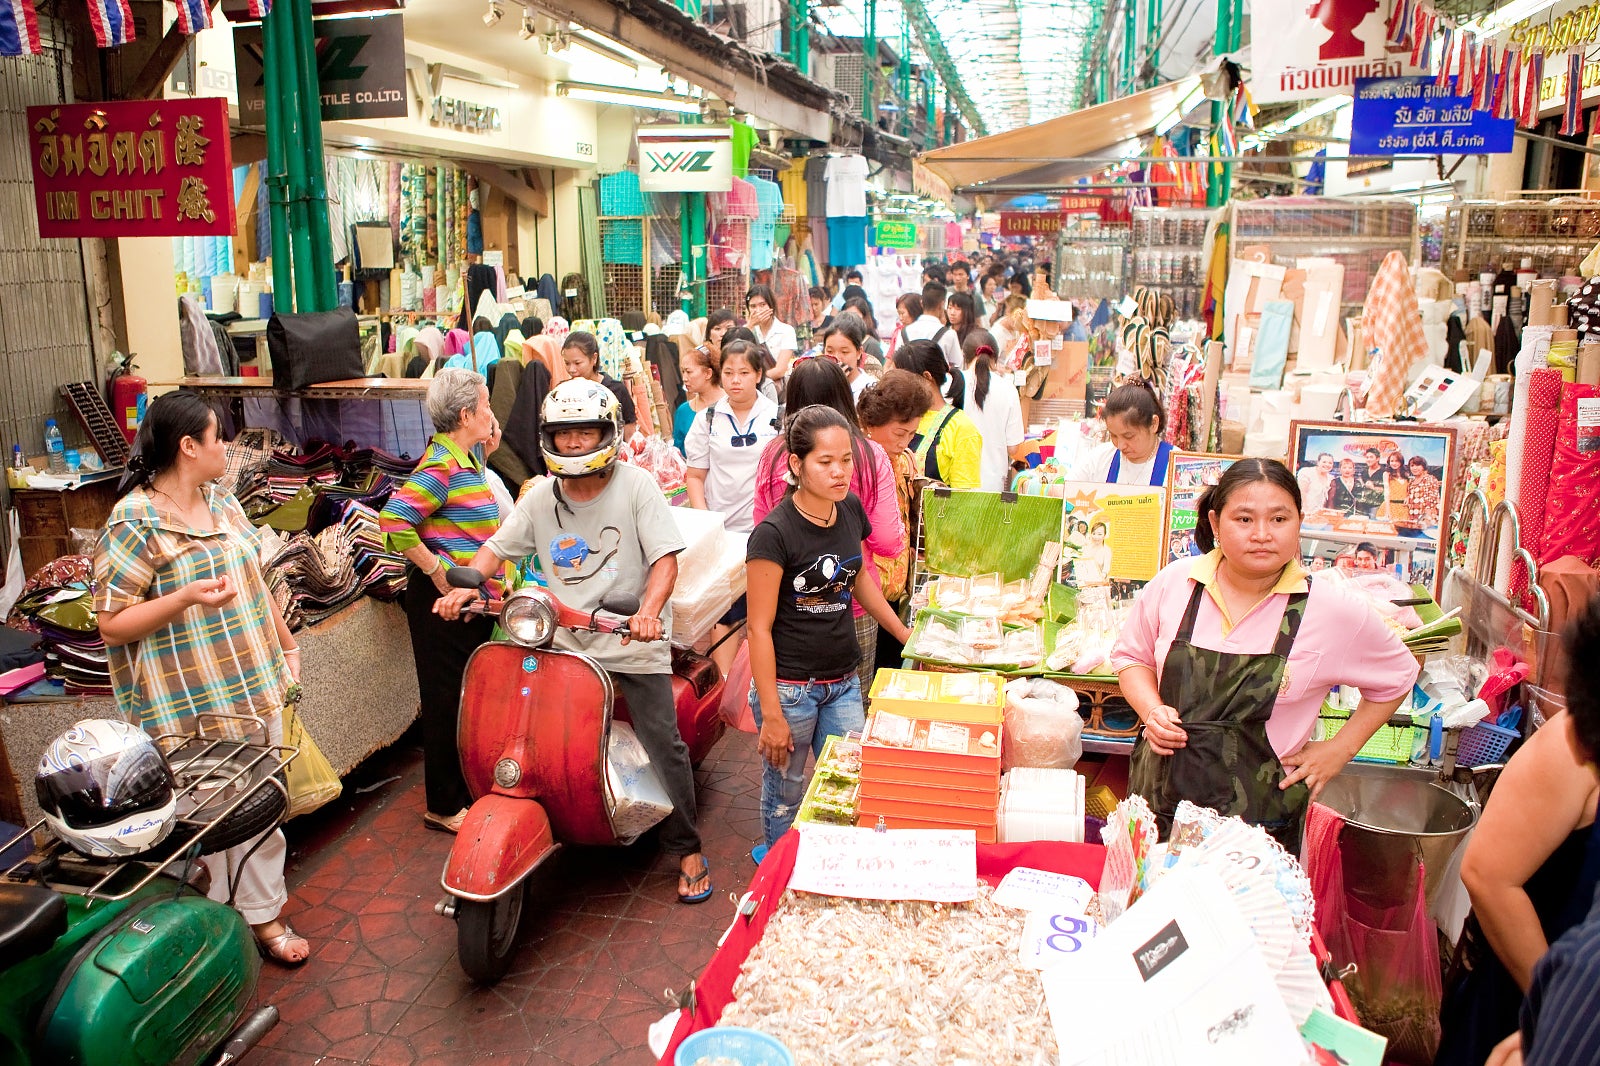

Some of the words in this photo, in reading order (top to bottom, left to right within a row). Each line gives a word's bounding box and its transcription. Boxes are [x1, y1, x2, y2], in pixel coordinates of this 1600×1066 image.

[1395, 106, 1412, 123] รับ
[576, 142, 592, 155] 133
[45, 191, 80, 220] IM
[90, 188, 165, 220] CHIT
[1046, 914, 1088, 953] 50
